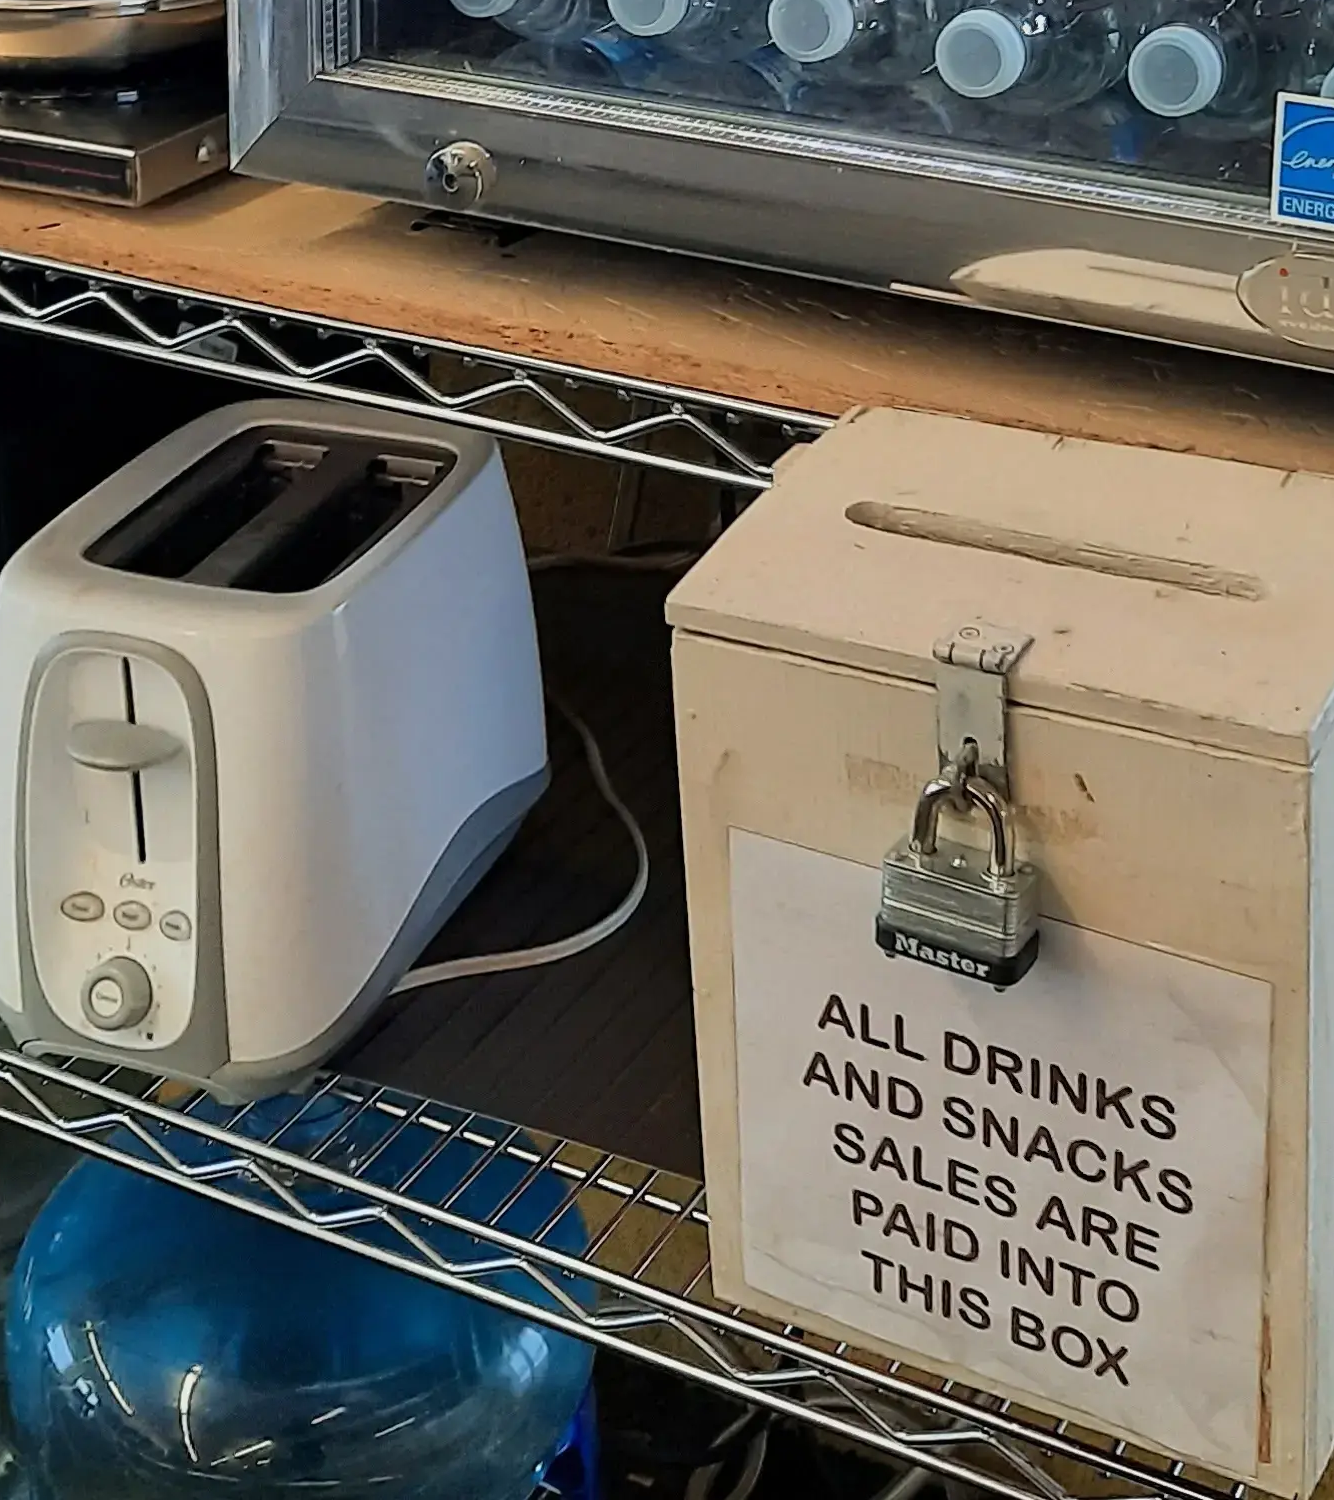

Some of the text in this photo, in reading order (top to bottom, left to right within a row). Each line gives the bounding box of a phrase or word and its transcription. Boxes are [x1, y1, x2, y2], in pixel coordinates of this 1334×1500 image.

[893, 930, 992, 980] Master
[801, 1050, 1195, 1216] AND SNACKS
[817, 993, 1178, 1142] ALL DRINKS
[832, 1121, 1162, 1273] SALES ARE
[851, 1188, 1142, 1324] PAID INTO
[860, 1249, 1130, 1386] THIS BOX
